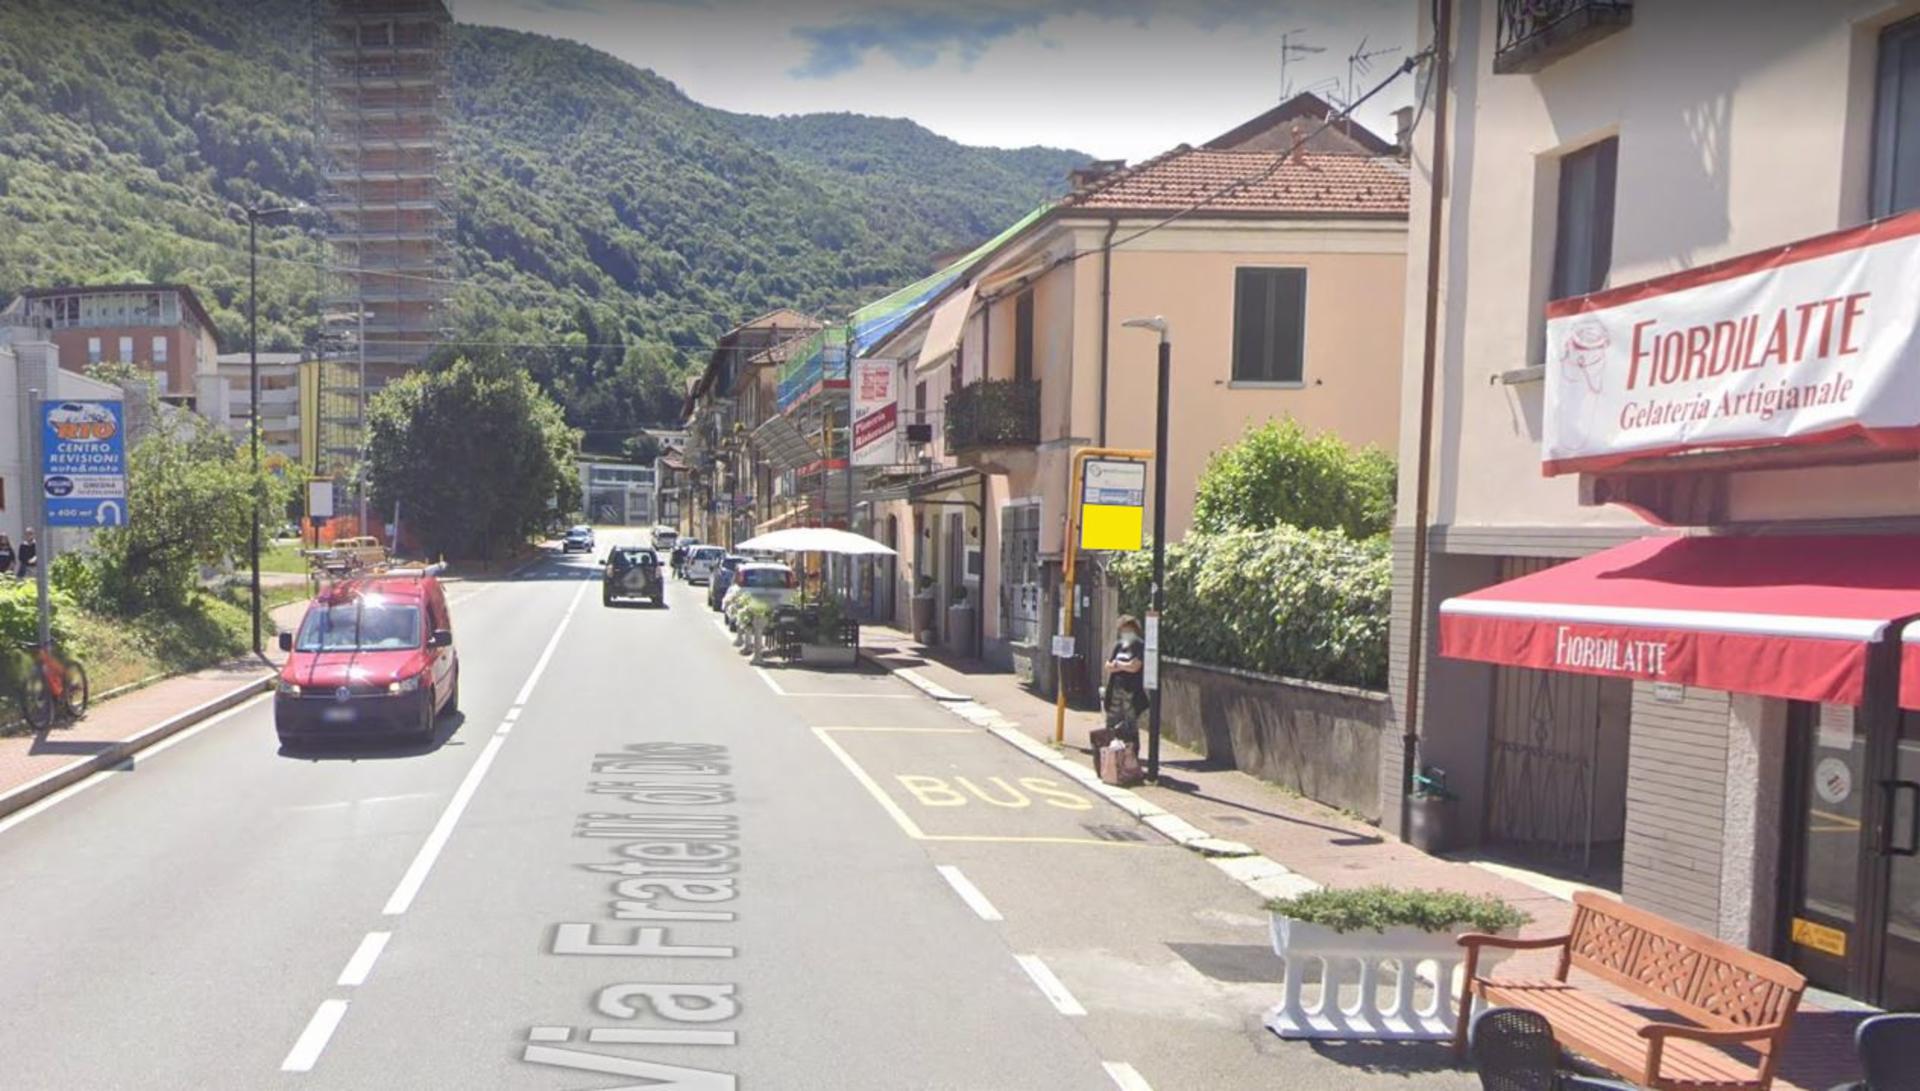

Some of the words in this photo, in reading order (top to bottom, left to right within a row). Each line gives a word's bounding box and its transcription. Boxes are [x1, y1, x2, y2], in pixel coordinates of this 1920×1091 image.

[1626, 291, 1872, 391] FIORDILATTE
[1619, 393, 1711, 431] Gelateria
[1713, 371, 1854, 421] Artigianale
[50, 454, 118, 464] REVISIONI
[57, 442, 110, 453] CENTRO
[50, 464, 119, 473] auto&moto
[1555, 625, 1668, 675] FIORDILATTE
[896, 774, 1093, 812] BUS
